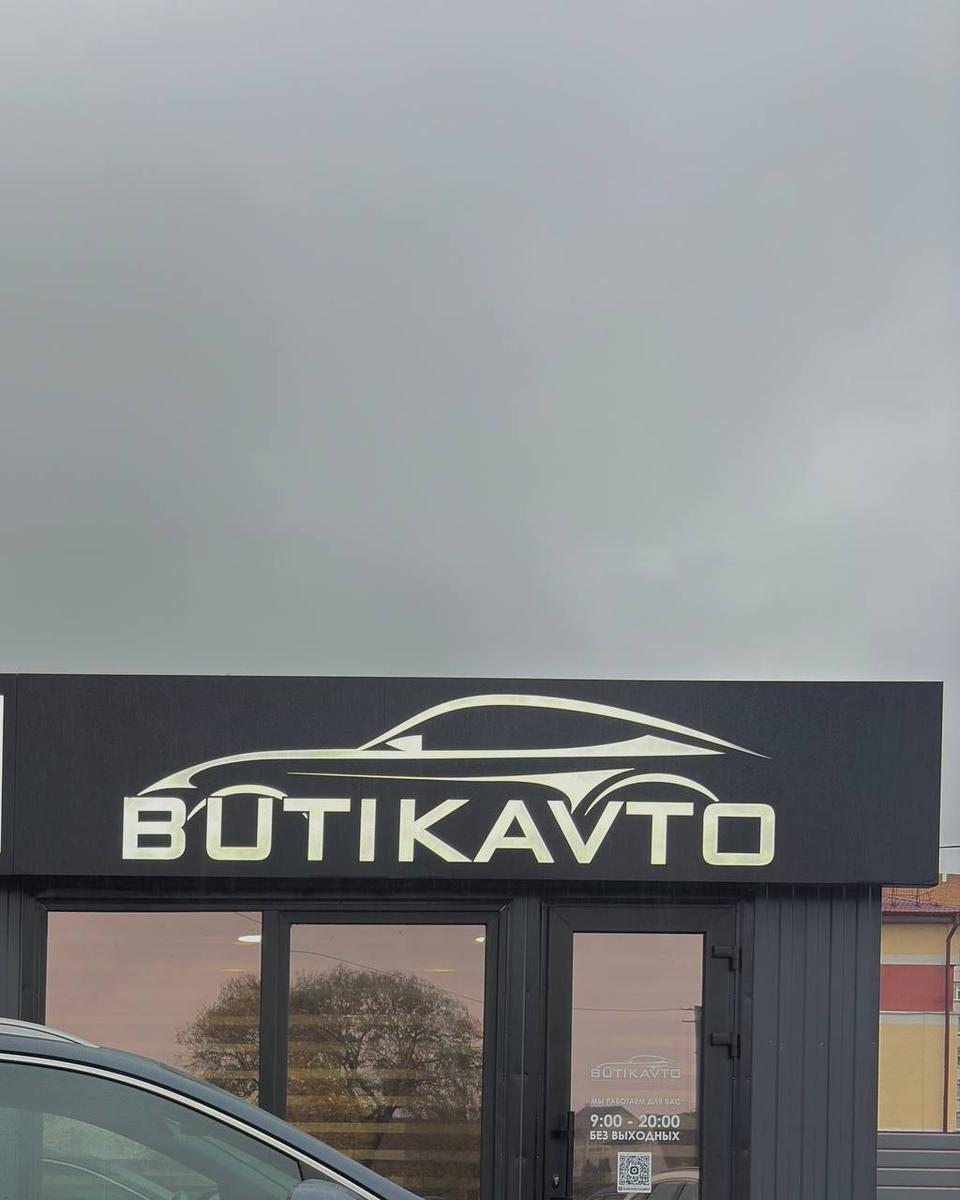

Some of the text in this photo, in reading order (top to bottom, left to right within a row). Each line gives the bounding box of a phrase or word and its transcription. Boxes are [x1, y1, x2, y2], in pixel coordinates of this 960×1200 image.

[121, 796, 777, 867] BUTIKAVTO
[591, 1067, 681, 1079] BUTIKAVTO
[590, 1114, 622, 1128] 9:00
[638, 1114, 680, 1128] 20:00
[589, 1130, 680, 1142] БЕЗ ВЫХОДНЫХ
